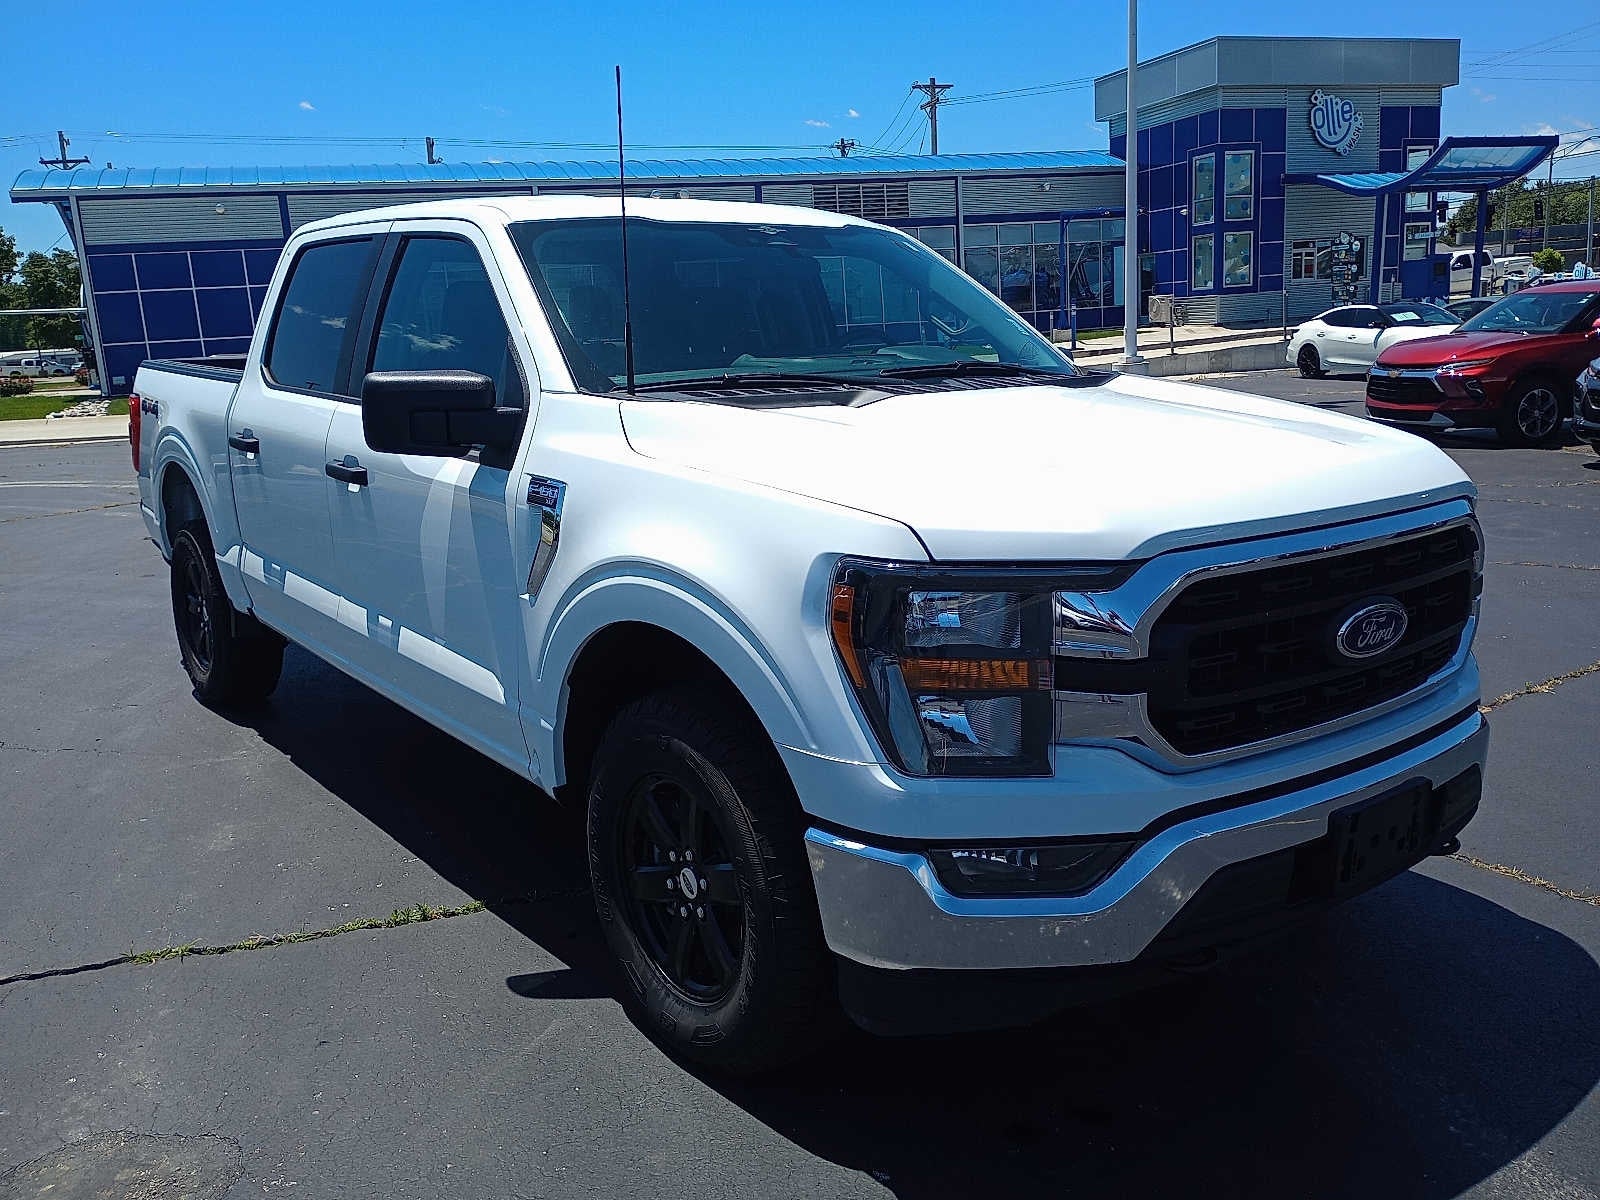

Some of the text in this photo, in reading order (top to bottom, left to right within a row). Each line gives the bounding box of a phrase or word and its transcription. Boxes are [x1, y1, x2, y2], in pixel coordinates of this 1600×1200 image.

[1313, 97, 1353, 137] ollie
[1346, 126, 1363, 150] WASH
[1357, 615, 1396, 648] Ford
